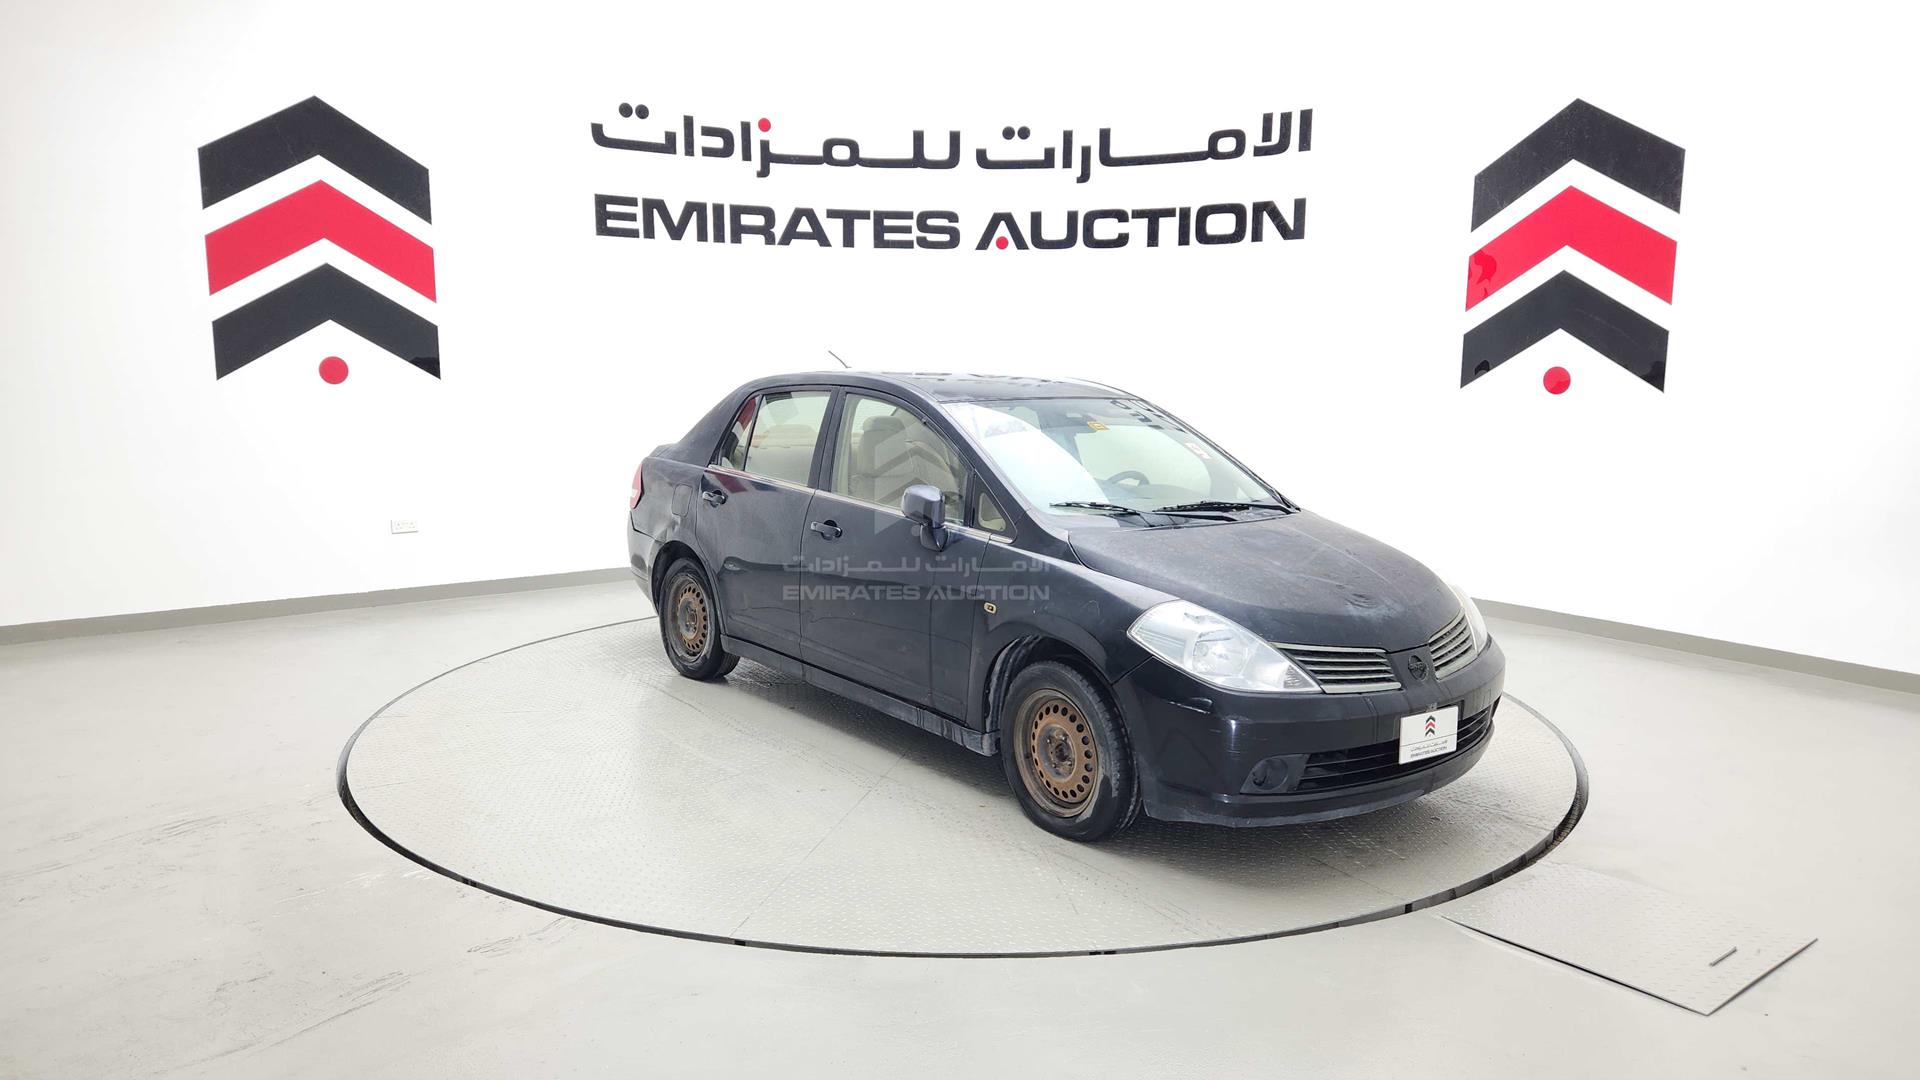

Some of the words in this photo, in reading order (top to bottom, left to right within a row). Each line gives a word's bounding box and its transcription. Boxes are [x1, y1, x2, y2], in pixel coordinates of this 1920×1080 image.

[591, 103, 960, 177] للمزادات
[595, 194, 960, 249] EMIRATES
[976, 198, 1306, 250] AUCTION
